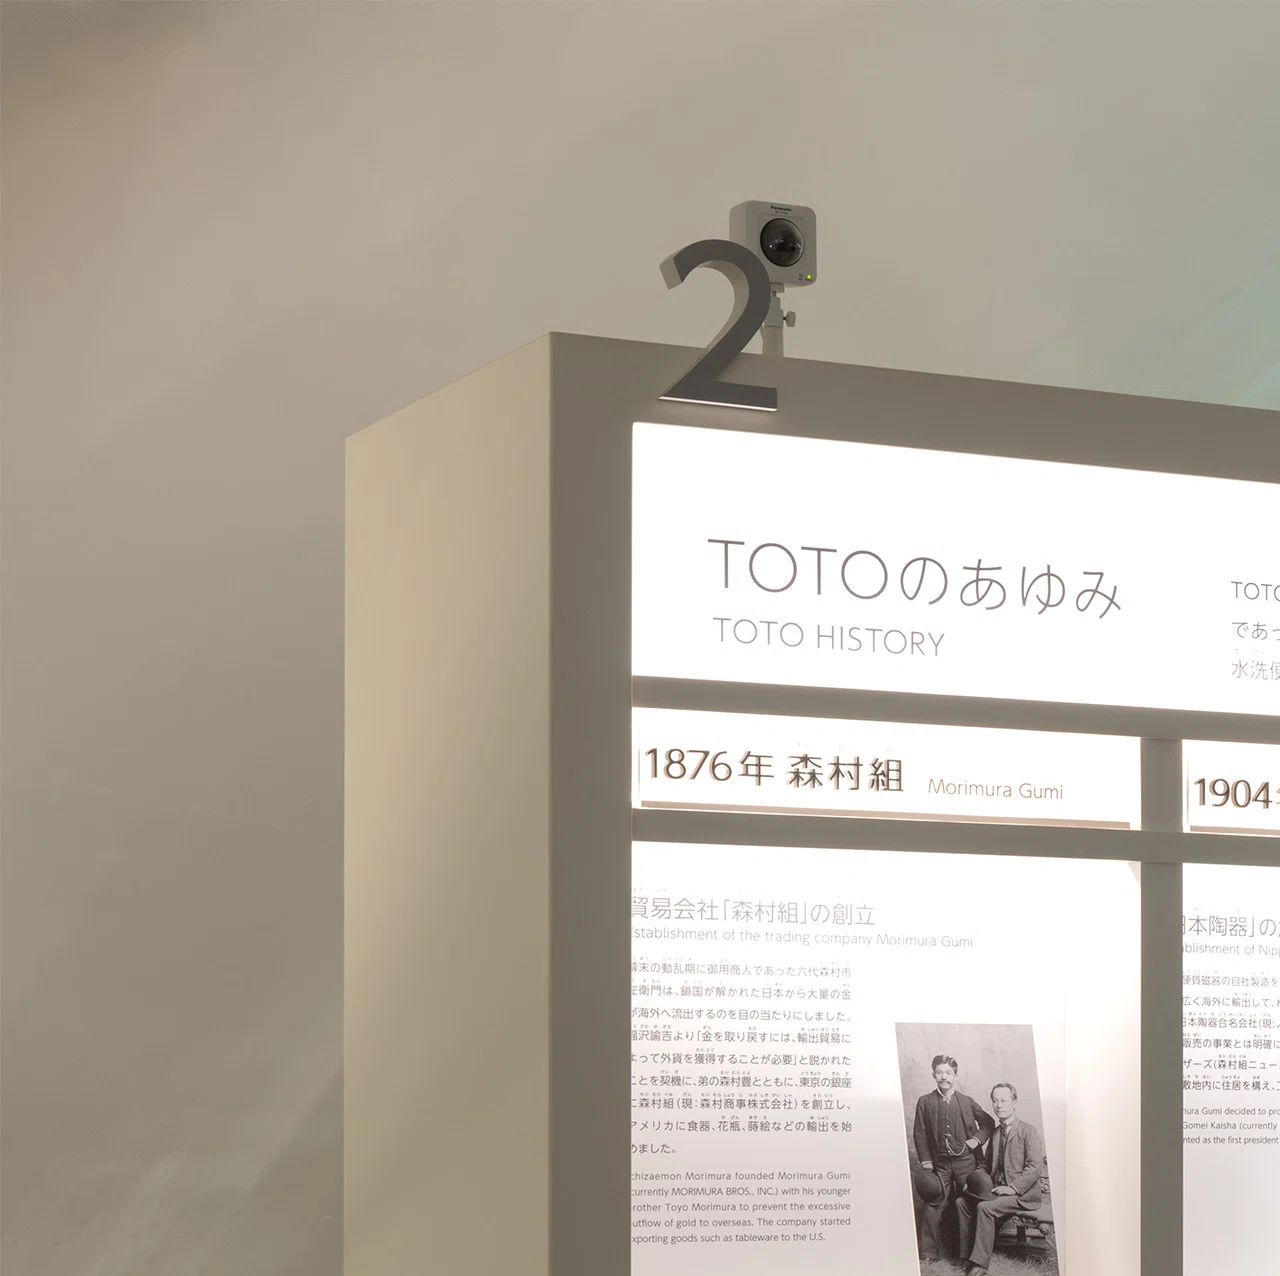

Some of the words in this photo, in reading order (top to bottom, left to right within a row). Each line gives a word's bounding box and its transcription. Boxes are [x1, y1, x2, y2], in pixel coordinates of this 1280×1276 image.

[658, 238, 778, 412] 2
[707, 538, 1122, 620] TOTOのあゆみ
[712, 616, 805, 648] TOTO
[816, 624, 945, 657] HISTORY
[645, 747, 775, 787] 1876年
[786, 753, 904, 792] 森村組
[927, 778, 1012, 798] Morimura
[1018, 782, 1063, 800] Gumi
[631, 925, 721, 941] stablishment
[722, 928, 736, 941] of
[739, 929, 761, 945] the
[763, 927, 813, 949] trading
[813, 933, 873, 949] company
[875, 933, 937, 949] Morimura
[940, 935, 974, 949] Gumi
[1183, 941, 1241, 957] blishment
[1243, 943, 1257, 957] of
[1210, 1119, 1237, 1133] Kaisha
[1238, 1119, 1278, 1133] (currently
[631, 1171, 683, 1181] chizaemon
[684, 1171, 732, 1181] Morimura
[734, 1171, 775, 1183] founded
[777, 1171, 824, 1181] Morimura
[825, 1171, 851, 1181] Gumi
[631, 1186, 670, 1200] currently
[670, 1186, 724, 1198] MORIMURA
[725, 1186, 755, 1197] BROS.,
[756, 1186, 779, 1197] INC.)
[780, 1186, 801, 1196] with
[801, 1186, 815, 1196] his
[816, 1187, 852, 1198] younger
[631, 1202, 662, 1213] rother
[664, 1202, 689, 1214] Toyo
[690, 1202, 737, 1212] Morimura
[738, 1202, 750, 1212] to
[751, 1202, 788, 1213] prevent
[788, 1200, 807, 1213] the
[807, 1201, 851, 1211] excessive
